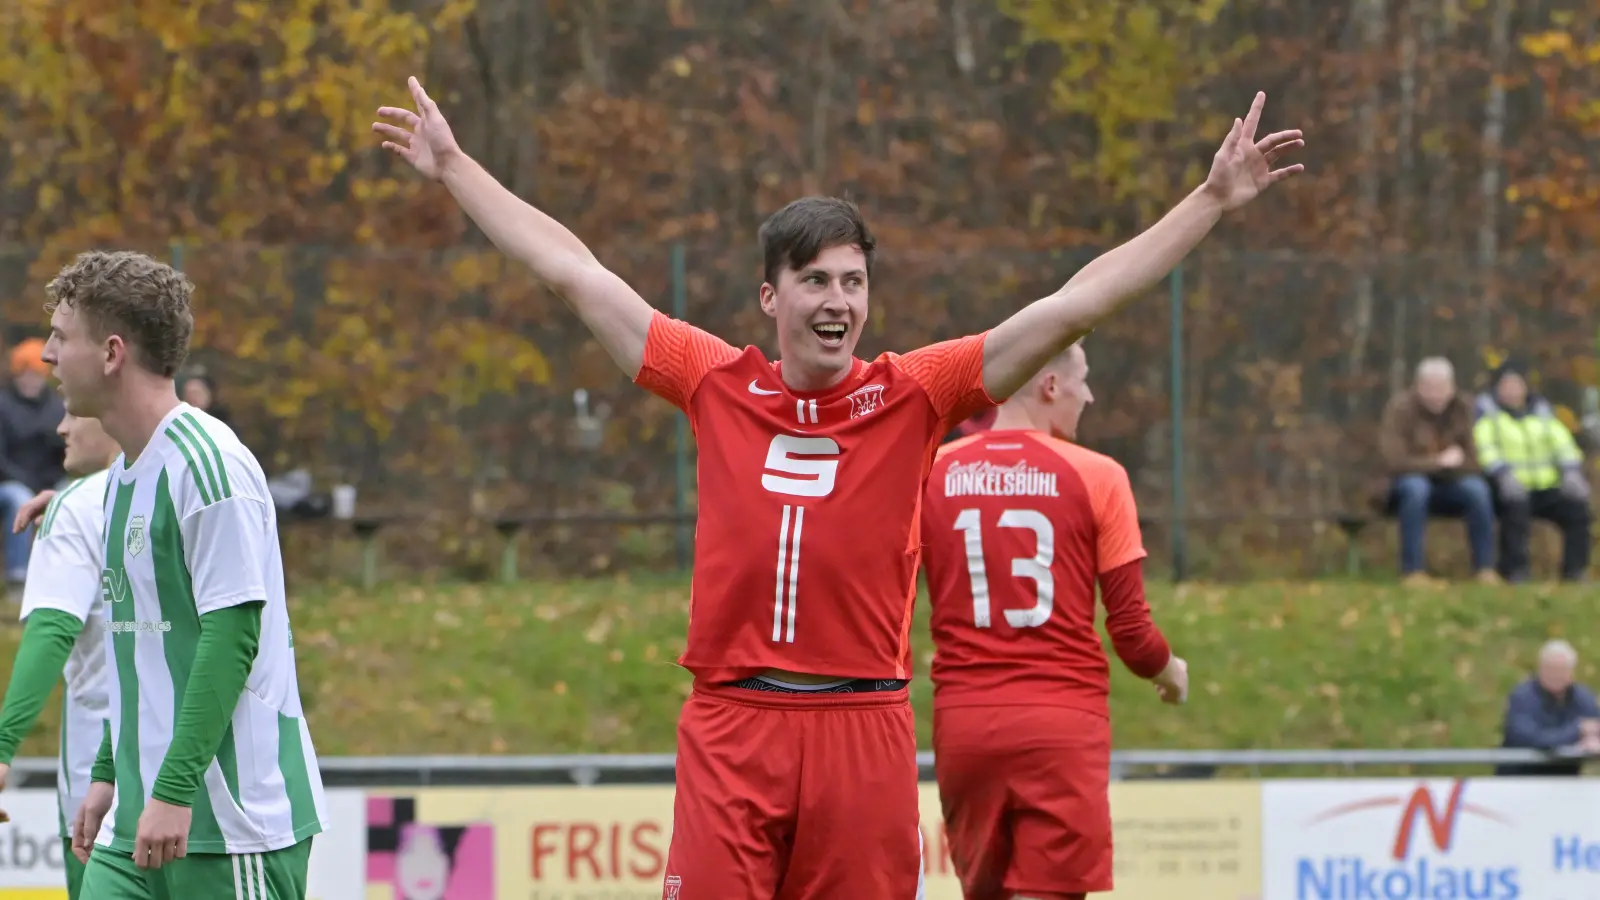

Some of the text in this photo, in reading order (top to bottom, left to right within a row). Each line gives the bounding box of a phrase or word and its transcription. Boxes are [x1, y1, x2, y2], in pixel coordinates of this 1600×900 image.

[761, 433, 840, 497] S
[944, 467, 1060, 497] DINKELSBÜHL
[953, 508, 1055, 629] 13
[1297, 857, 1520, 900] Nikolaus
